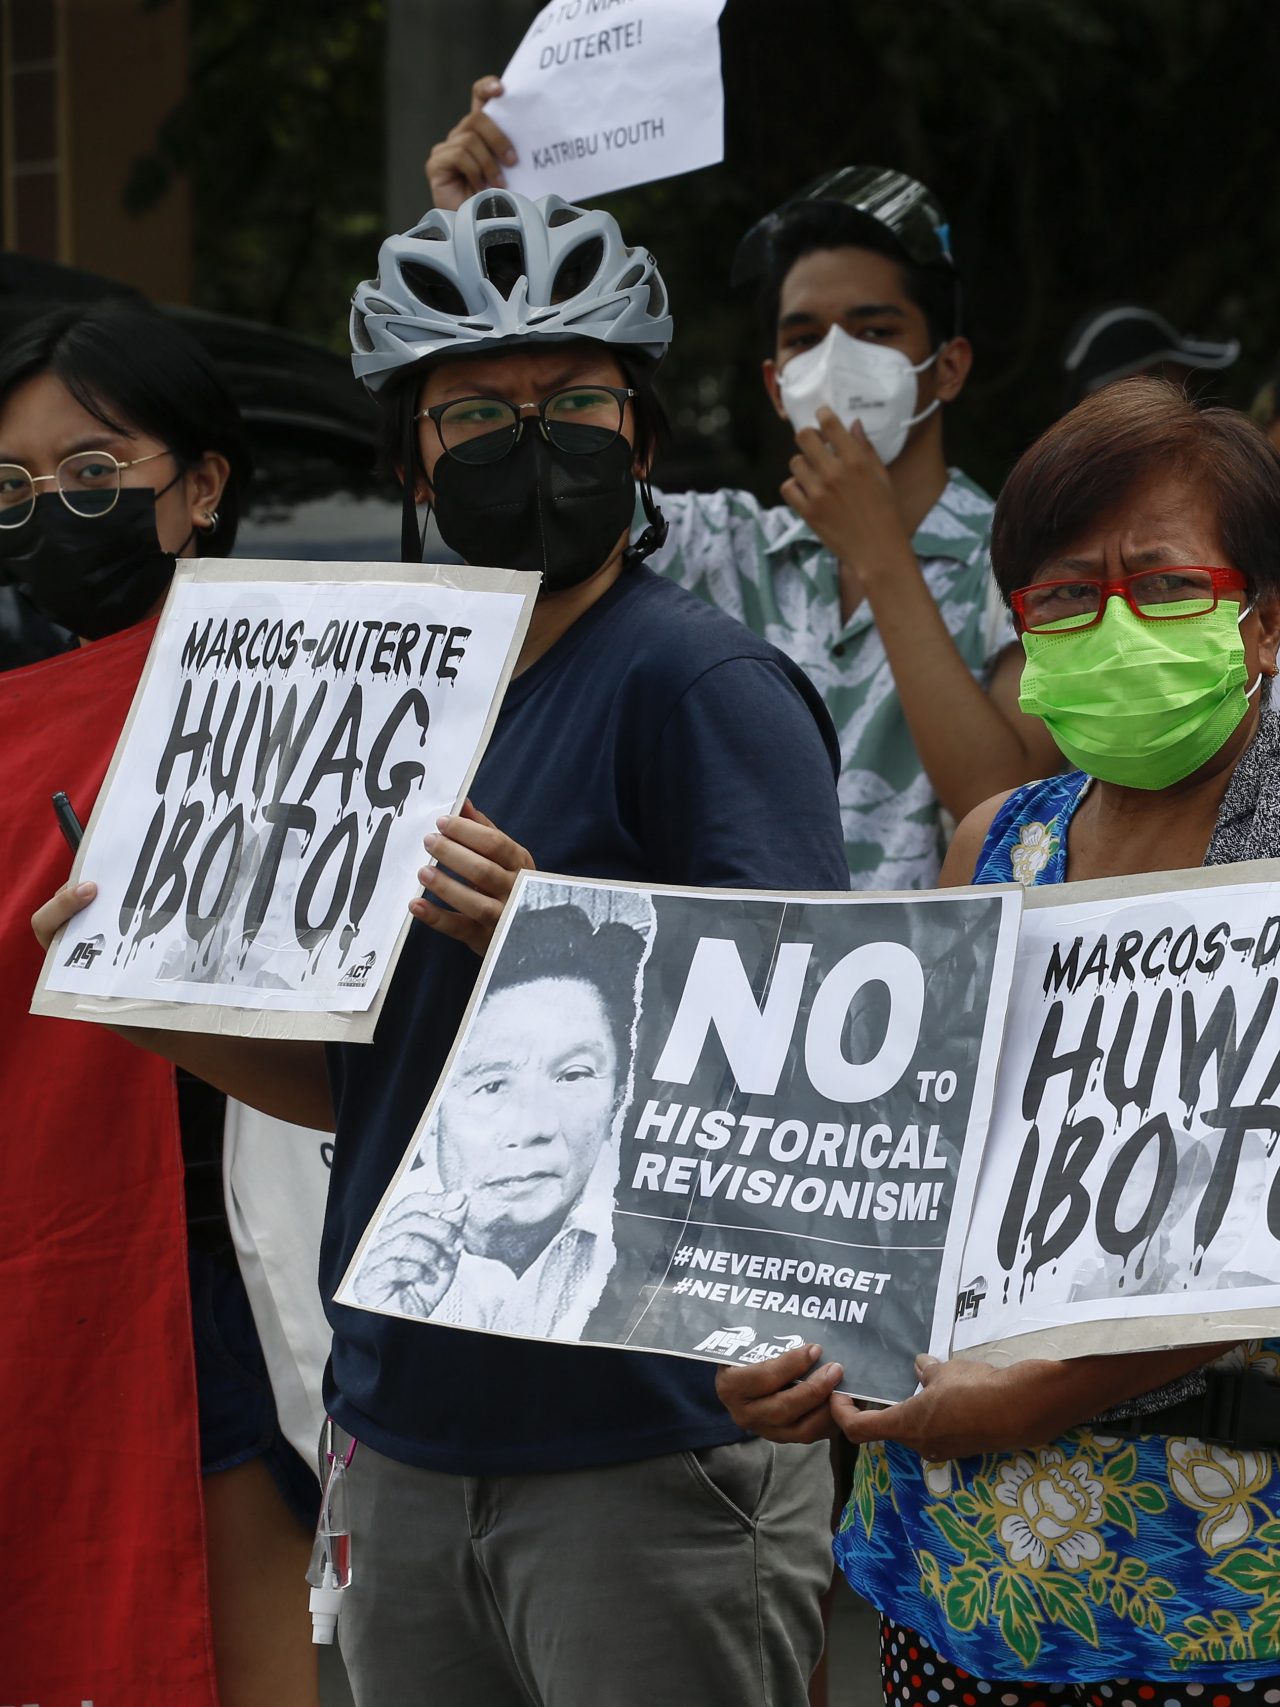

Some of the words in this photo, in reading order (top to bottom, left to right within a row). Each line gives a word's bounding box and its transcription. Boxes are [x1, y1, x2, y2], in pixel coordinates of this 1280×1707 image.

[539, 19, 644, 70] DUTERTE!
[532, 133, 599, 170] KATRIBU
[603, 117, 665, 151] YOUTH
[181, 618, 472, 685] MARCOS-DUTERTE
[156, 680, 430, 815] HUWAG
[116, 800, 394, 970] IBOTO!
[340, 964, 372, 981] ACT
[652, 937, 925, 1103] NO
[916, 1070, 957, 1103] TO
[635, 1100, 947, 1170] HISTORICAL
[631, 1151, 943, 1222] REVISIONISM!
[672, 1277, 868, 1324] #NEVERAGAIN
[674, 1246, 891, 1295] #NEVERFORGET
[742, 1342, 789, 1359] AC
